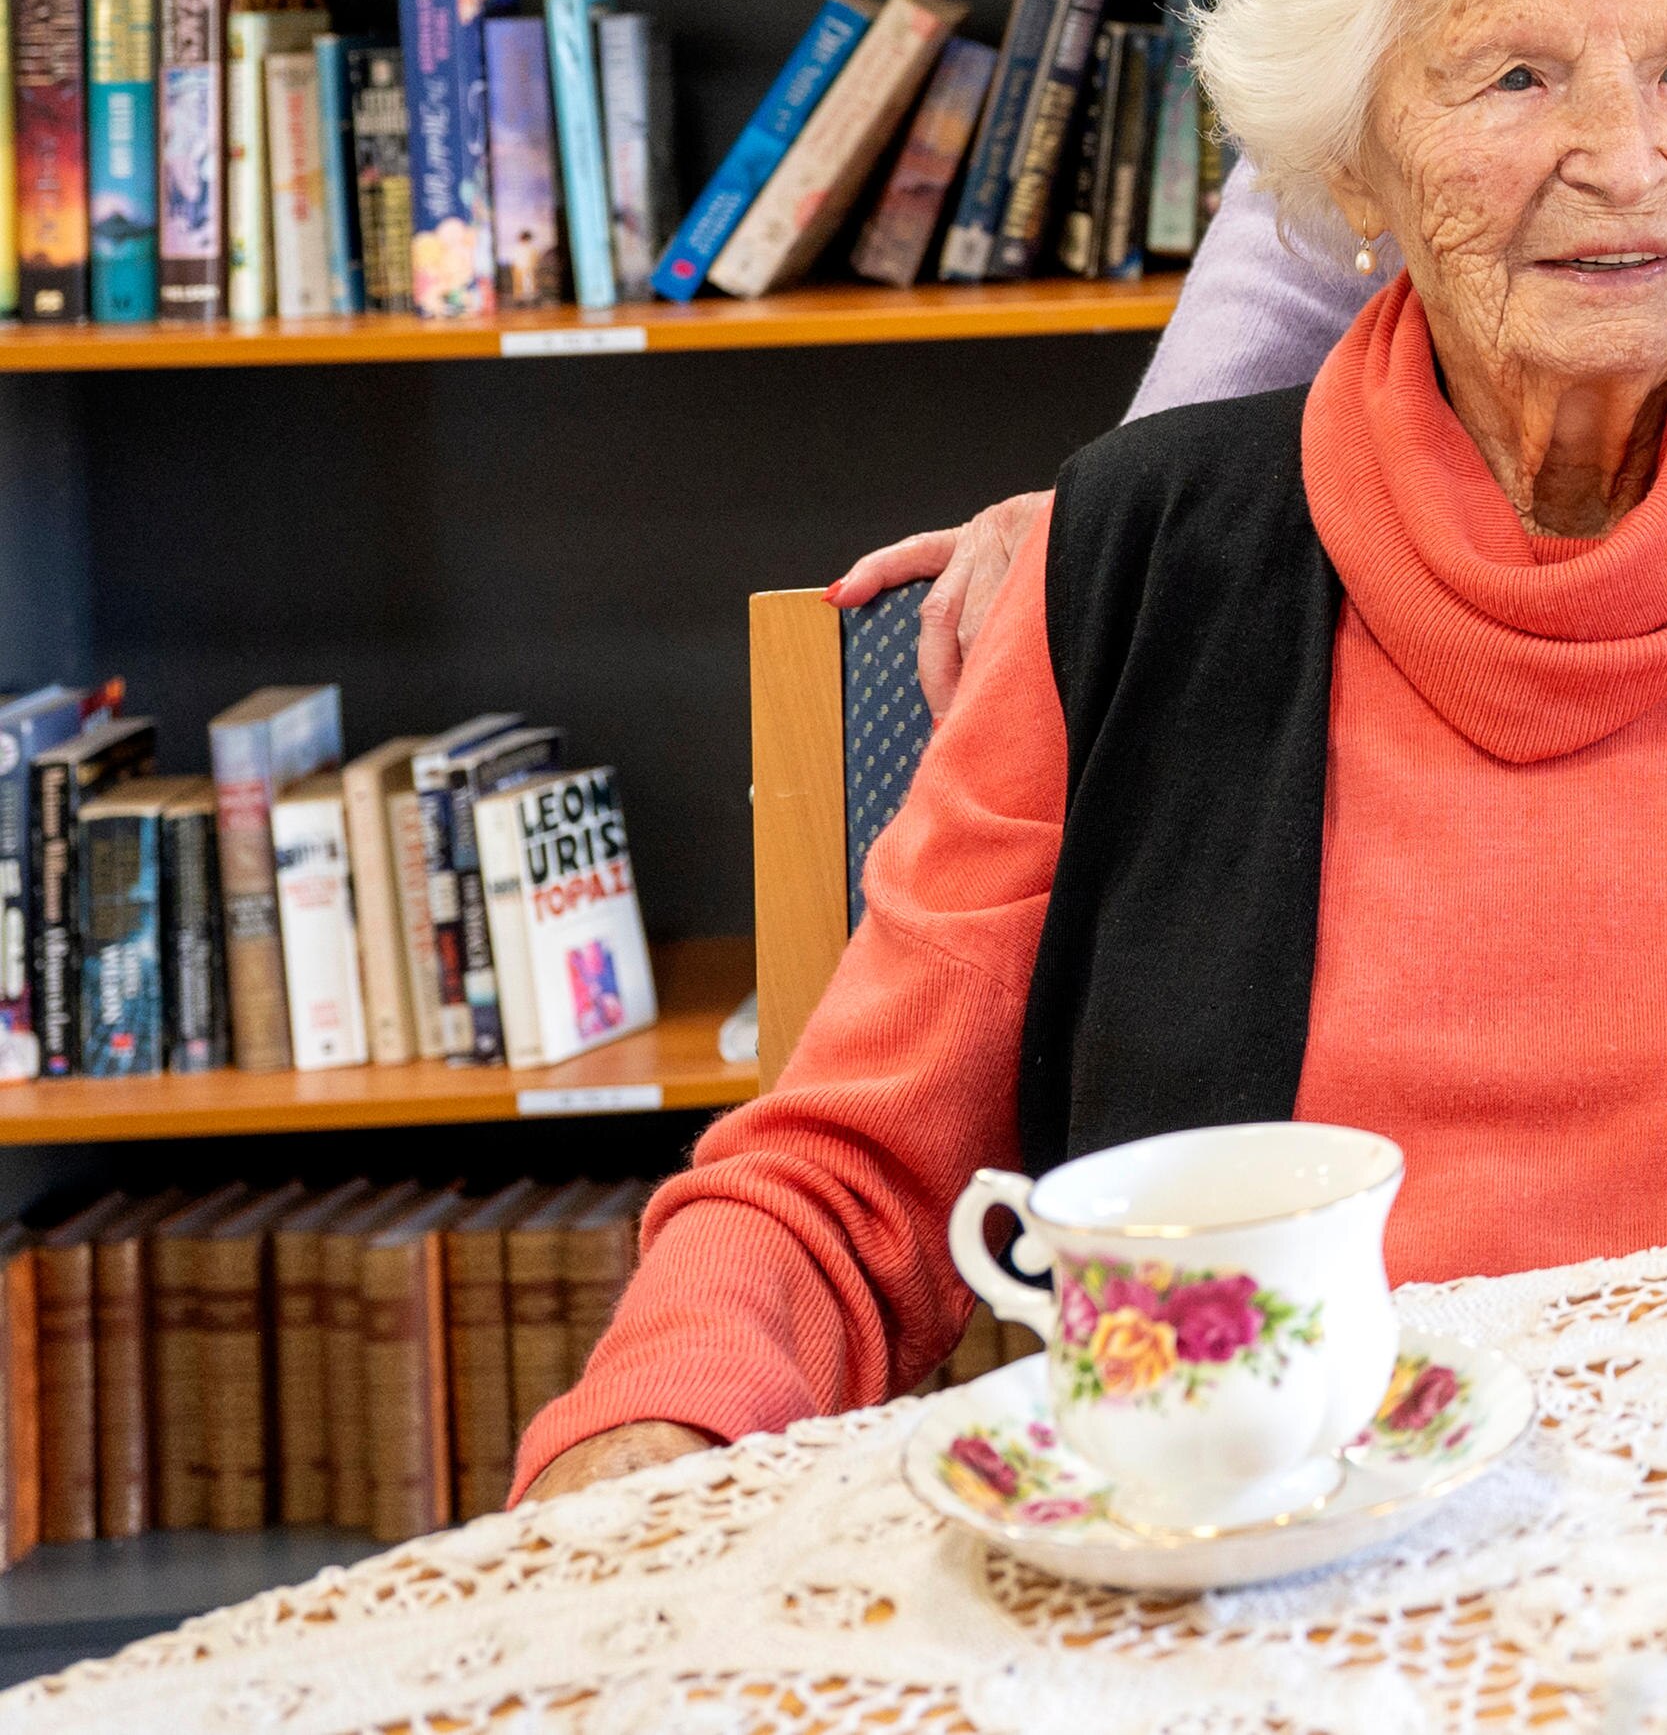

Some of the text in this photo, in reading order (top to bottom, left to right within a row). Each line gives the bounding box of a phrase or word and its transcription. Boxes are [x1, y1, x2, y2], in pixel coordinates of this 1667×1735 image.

[520, 776, 613, 838] LEON
[527, 820, 620, 884] URIS
[533, 859, 631, 922] TOPAZ
